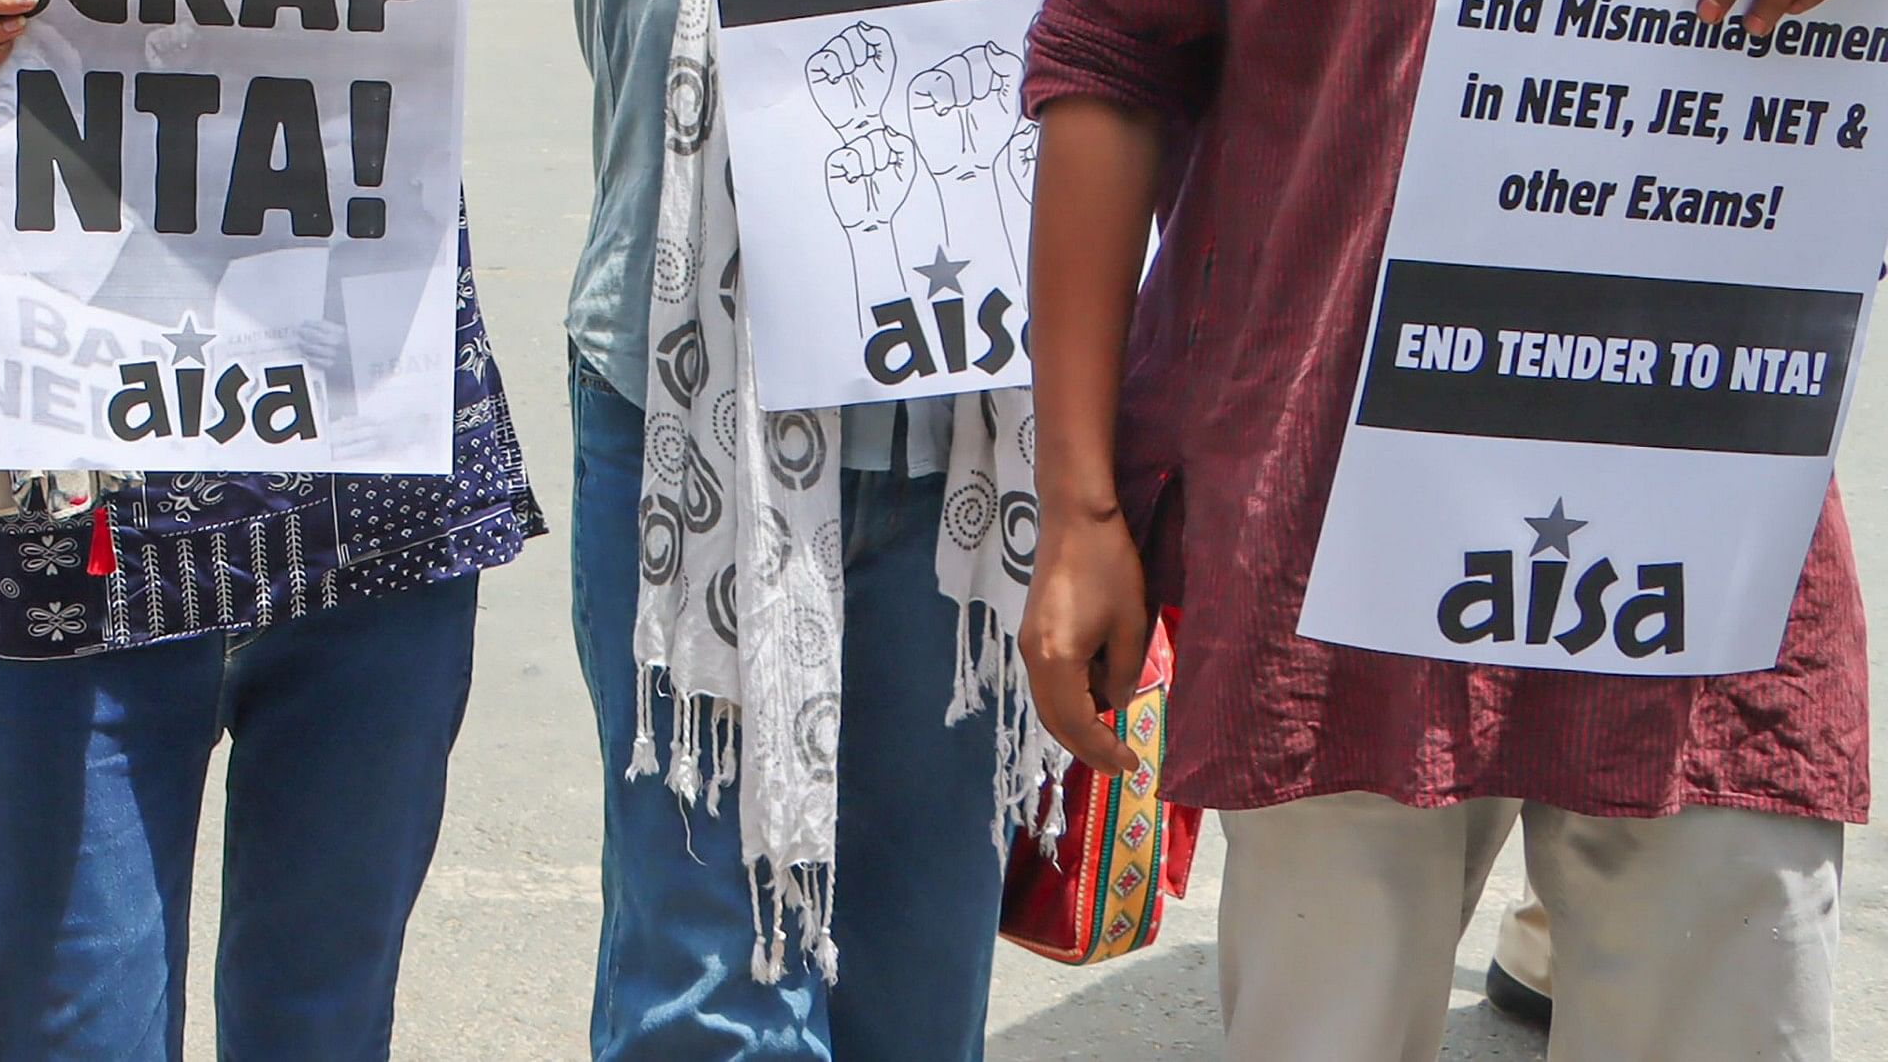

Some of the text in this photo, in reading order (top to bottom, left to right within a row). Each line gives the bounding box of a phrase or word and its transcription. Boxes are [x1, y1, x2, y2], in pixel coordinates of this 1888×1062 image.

[14, 69, 392, 238] NTA!
[1460, 74, 1869, 150] in NEET, JEE, NET &
[1498, 169, 1784, 230] other Exams!
[864, 287, 1031, 386] ais
[1396, 323, 1829, 397] END TENDER TO NTA!
[108, 361, 320, 444] aisa
[1437, 550, 1686, 657] aisa
